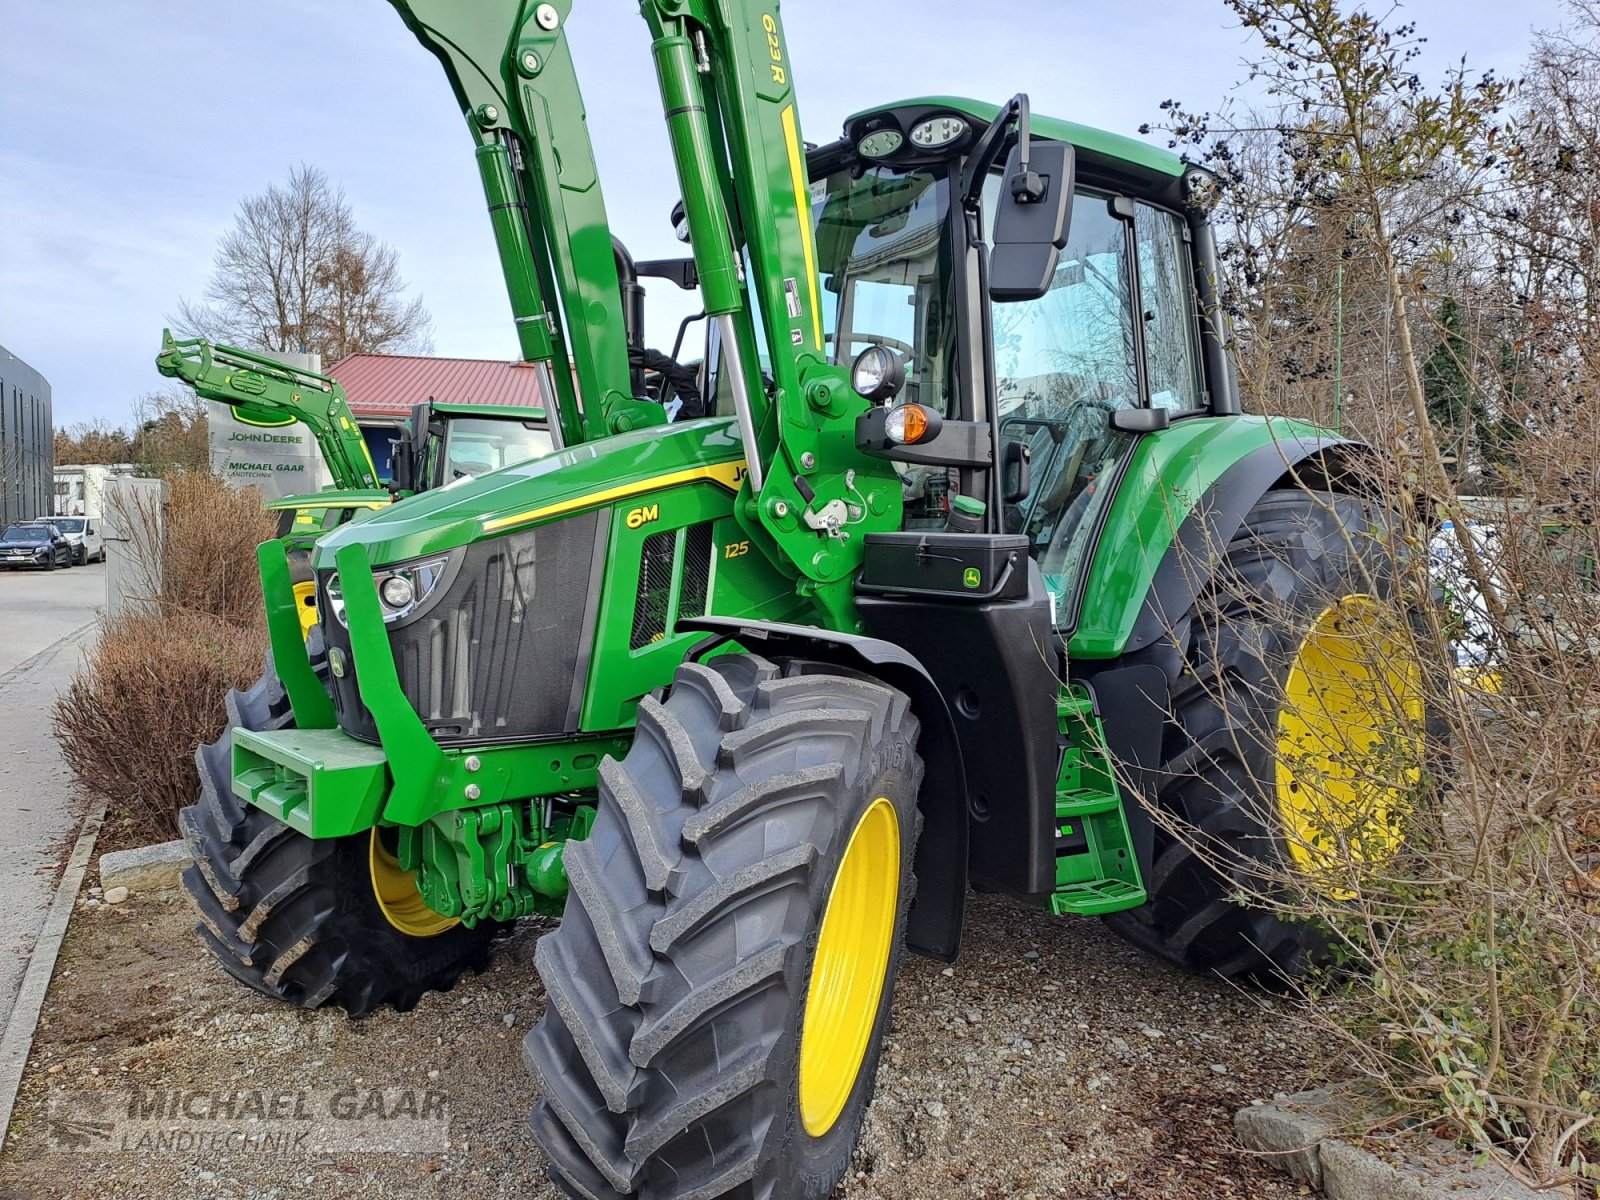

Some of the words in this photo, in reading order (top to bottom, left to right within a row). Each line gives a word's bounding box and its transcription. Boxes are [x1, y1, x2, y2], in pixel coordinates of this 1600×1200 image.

[228, 432, 261, 442] JOHN
[263, 433, 303, 444] DEERE
[228, 462, 274, 472] MICHAEL
[276, 464, 305, 473] GAAR
[227, 471, 272, 479] LANDTECHNIK
[626, 504, 659, 530] 6M
[724, 541, 750, 559] 125
